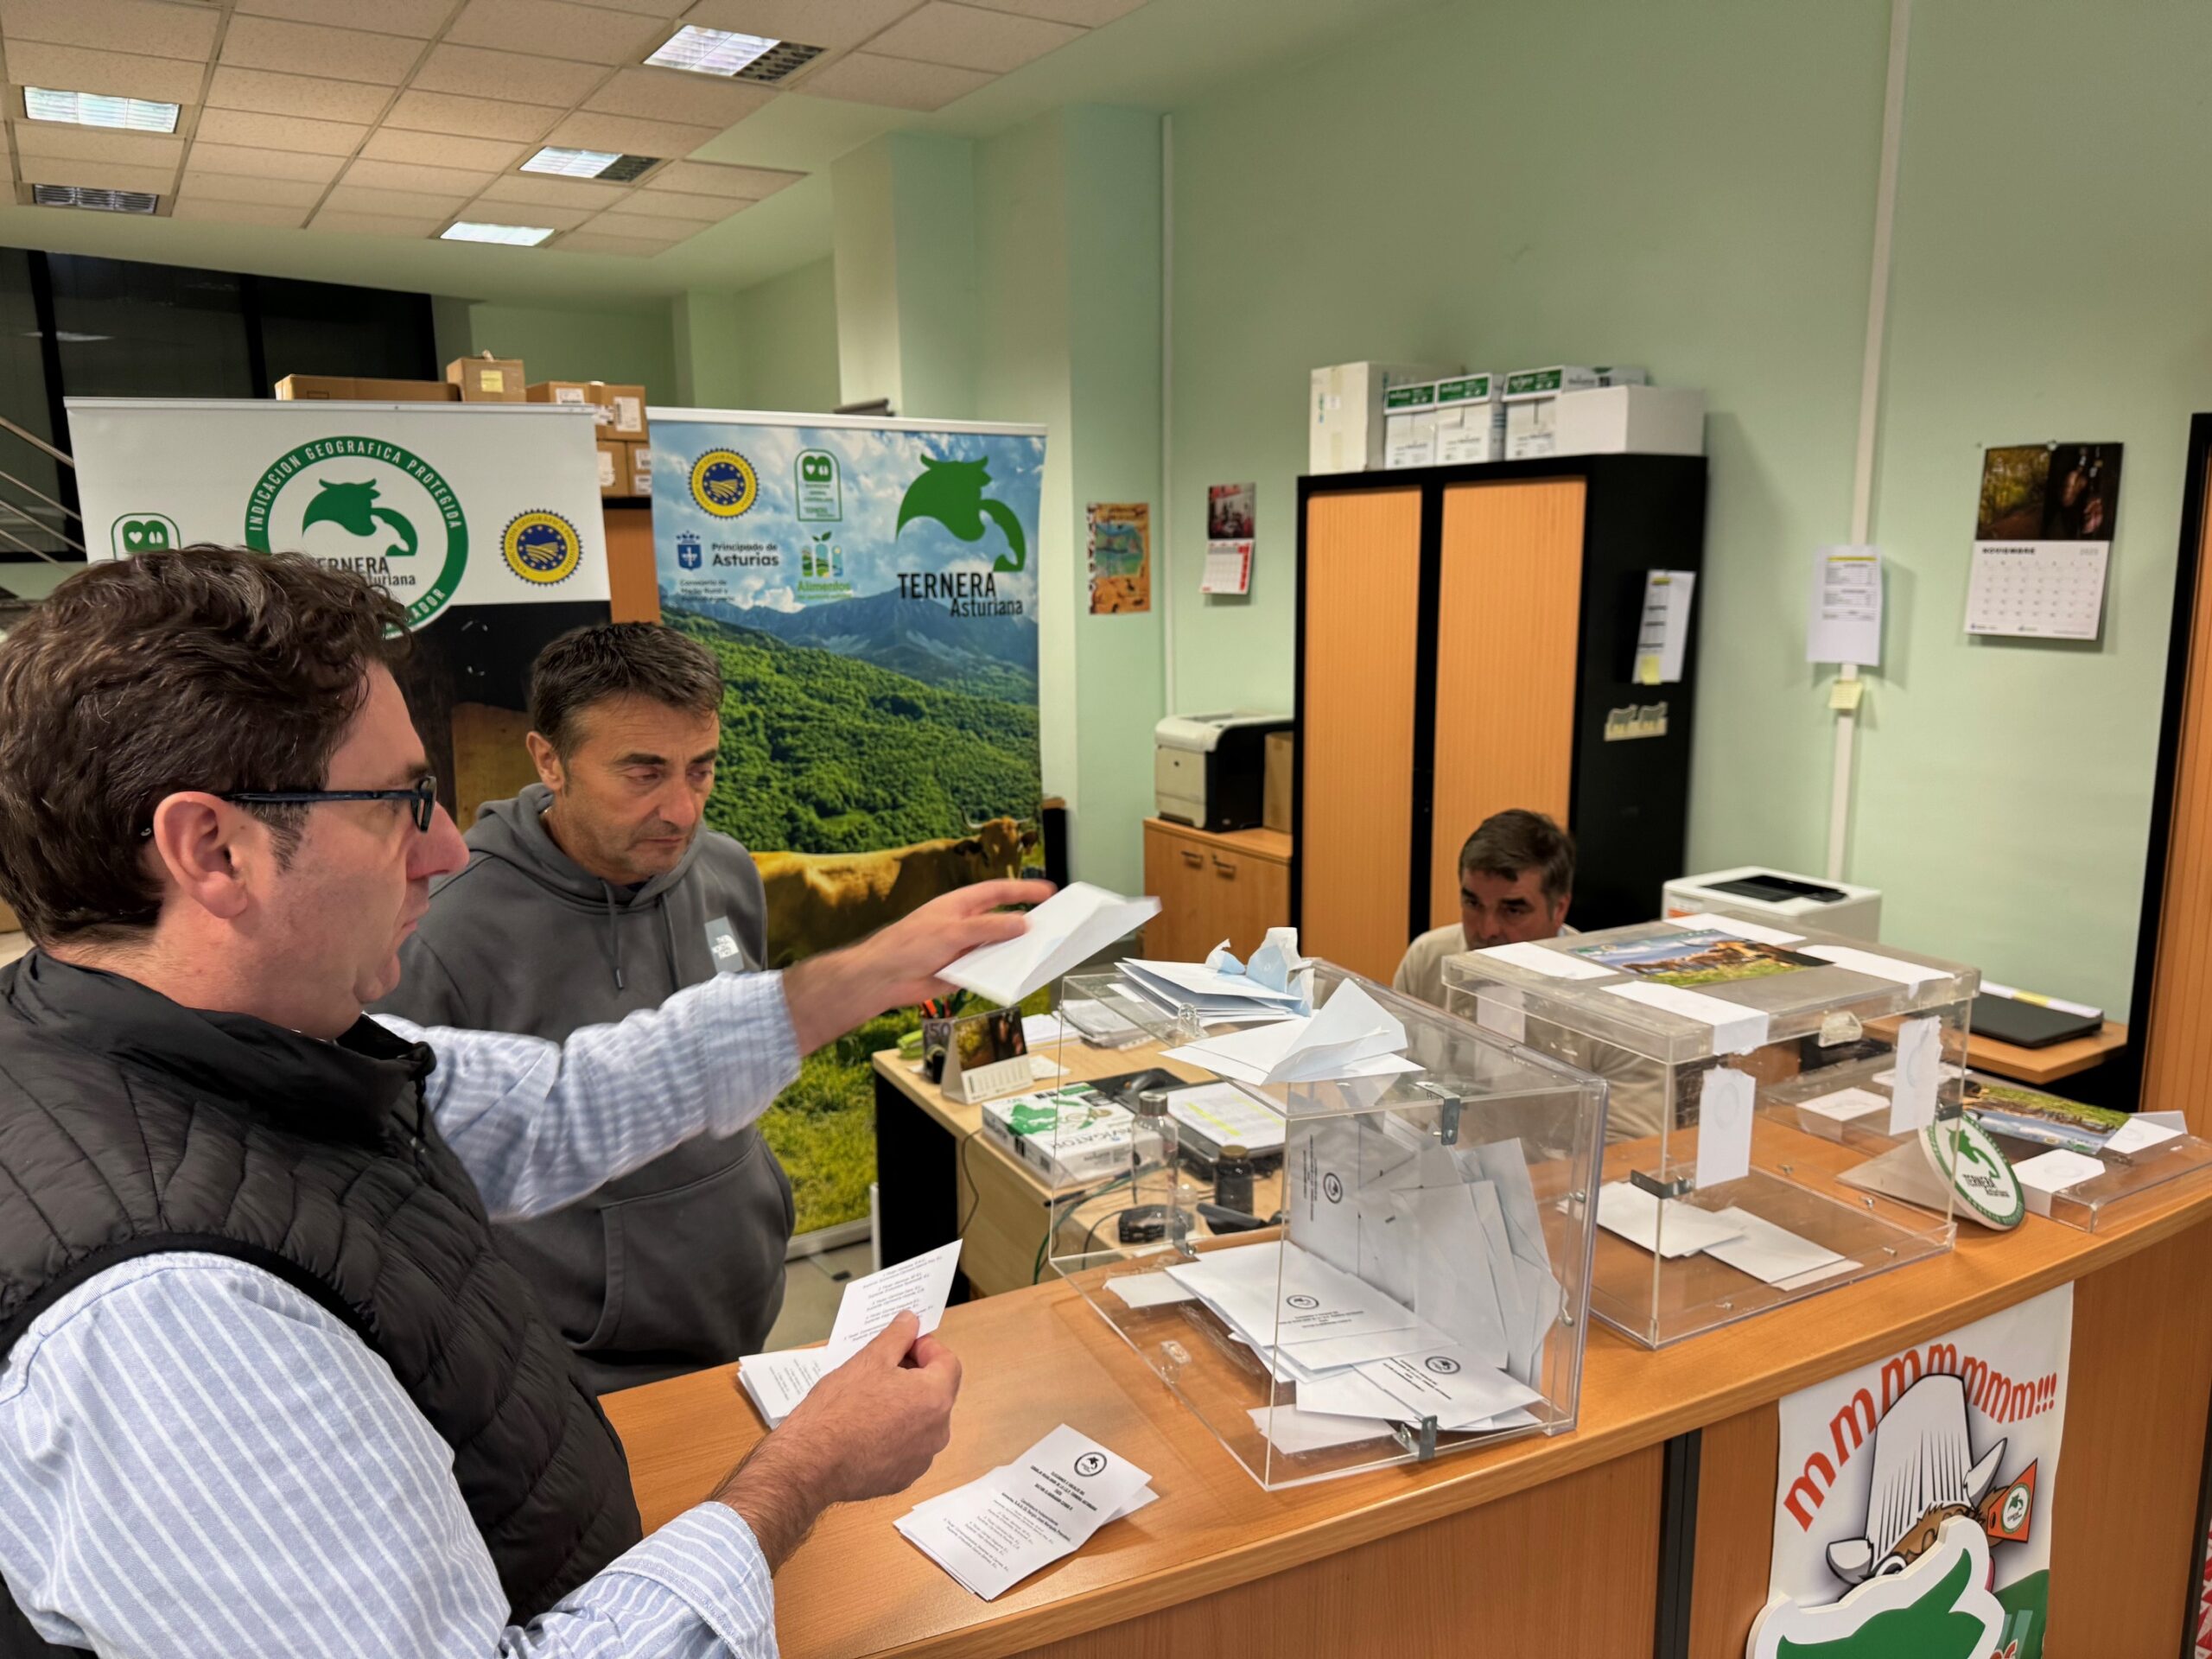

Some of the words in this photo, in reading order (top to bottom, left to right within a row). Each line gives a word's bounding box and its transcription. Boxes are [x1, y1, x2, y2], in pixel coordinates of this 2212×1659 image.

[249, 454, 302, 531] INDICACION
[304, 439, 402, 464] GEOGRAFICA
[407, 460, 462, 530] PROTEGIDA
[712, 543, 763, 552] Principado
[766, 543, 778, 551] de
[316, 556, 390, 574] ERNERA
[712, 552, 779, 567] Asturias
[897, 571, 996, 599] TERNERA
[950, 598, 1024, 617] Asturiana
